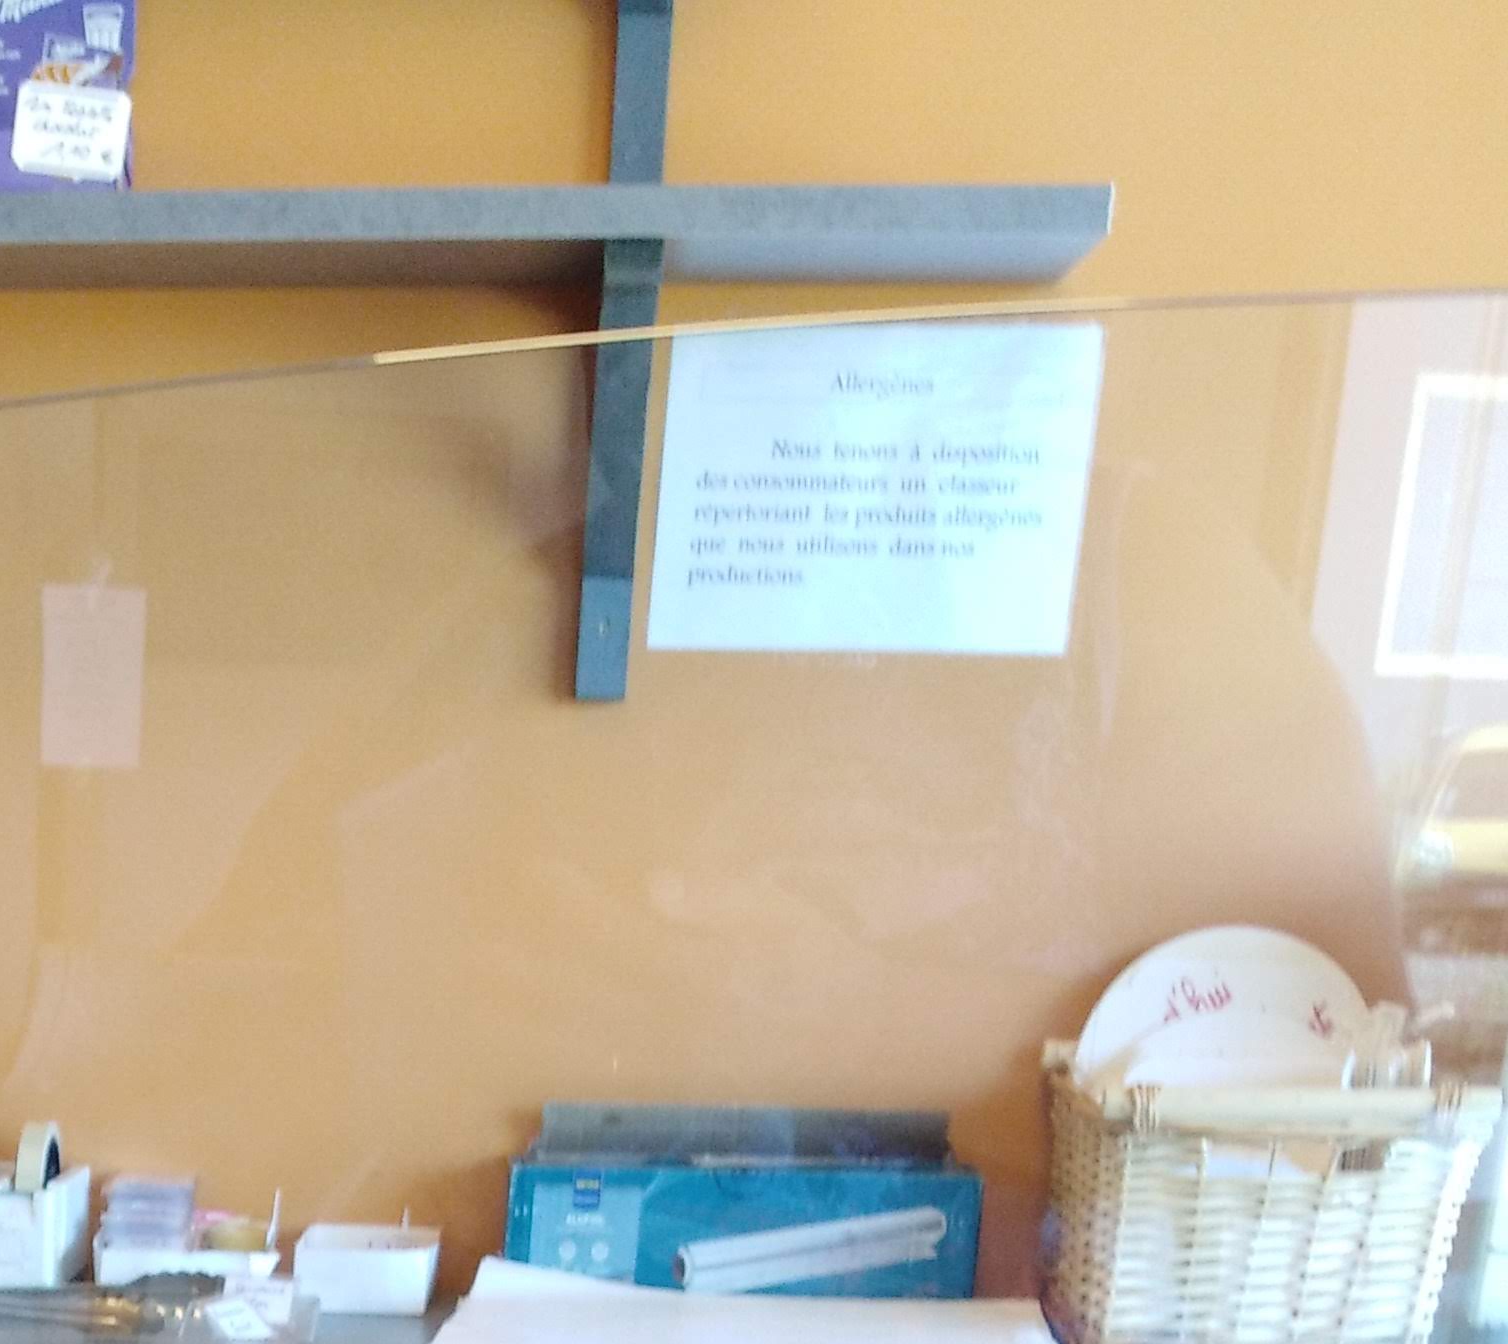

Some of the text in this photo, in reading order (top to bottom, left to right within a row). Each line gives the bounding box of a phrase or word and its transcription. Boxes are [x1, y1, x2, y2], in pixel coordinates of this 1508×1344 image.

[771, 438, 821, 460] Nous
[834, 440, 897, 462] tenons
[933, 440, 1039, 468] disposition
[696, 469, 1015, 494] des consommateurs un classeur
[855, 503, 936, 528] produits
[690, 535, 975, 558] que nous utilisons dans nos
